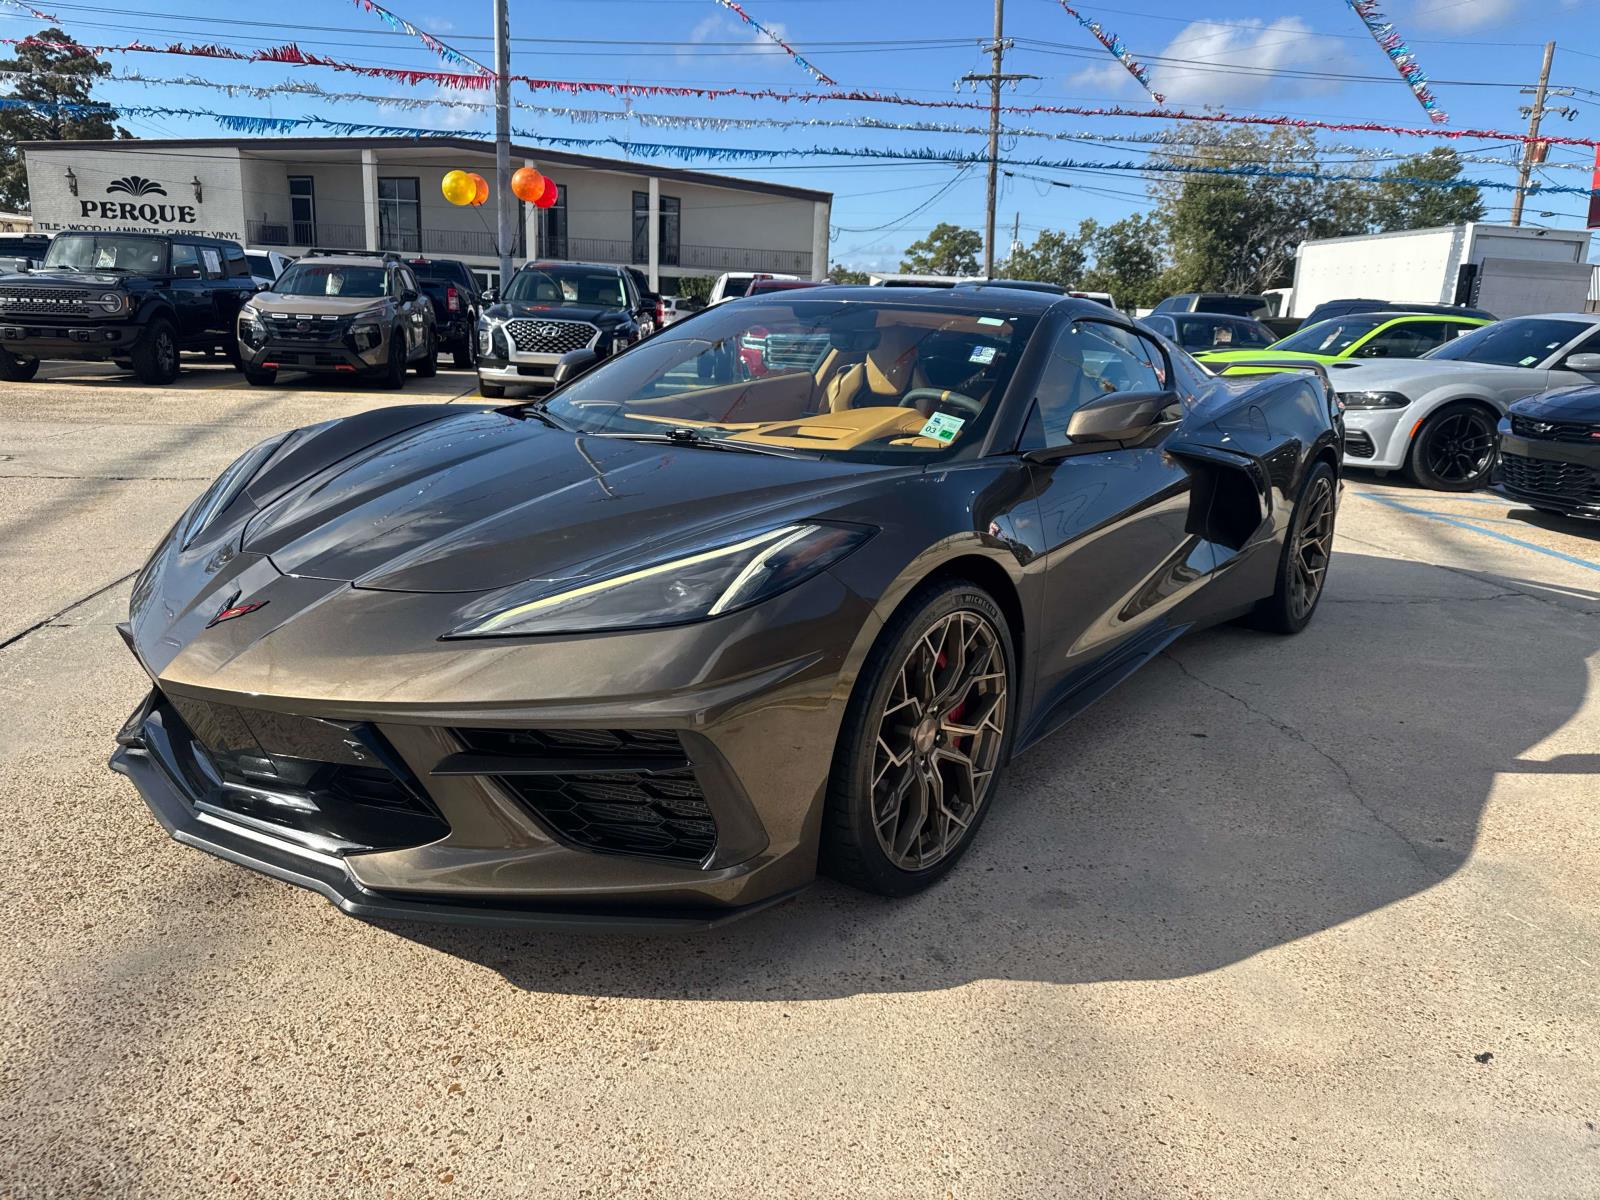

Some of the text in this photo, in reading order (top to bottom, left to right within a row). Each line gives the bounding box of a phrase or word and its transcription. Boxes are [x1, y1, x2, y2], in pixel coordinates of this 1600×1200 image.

[80, 200, 197, 224] PERQUE
[38, 222, 61, 231] TILE
[67, 223, 101, 231] WOOD
[211, 231, 242, 240] VINYL
[925, 425, 937, 434] 03
[964, 595, 997, 616] MICHELIN
